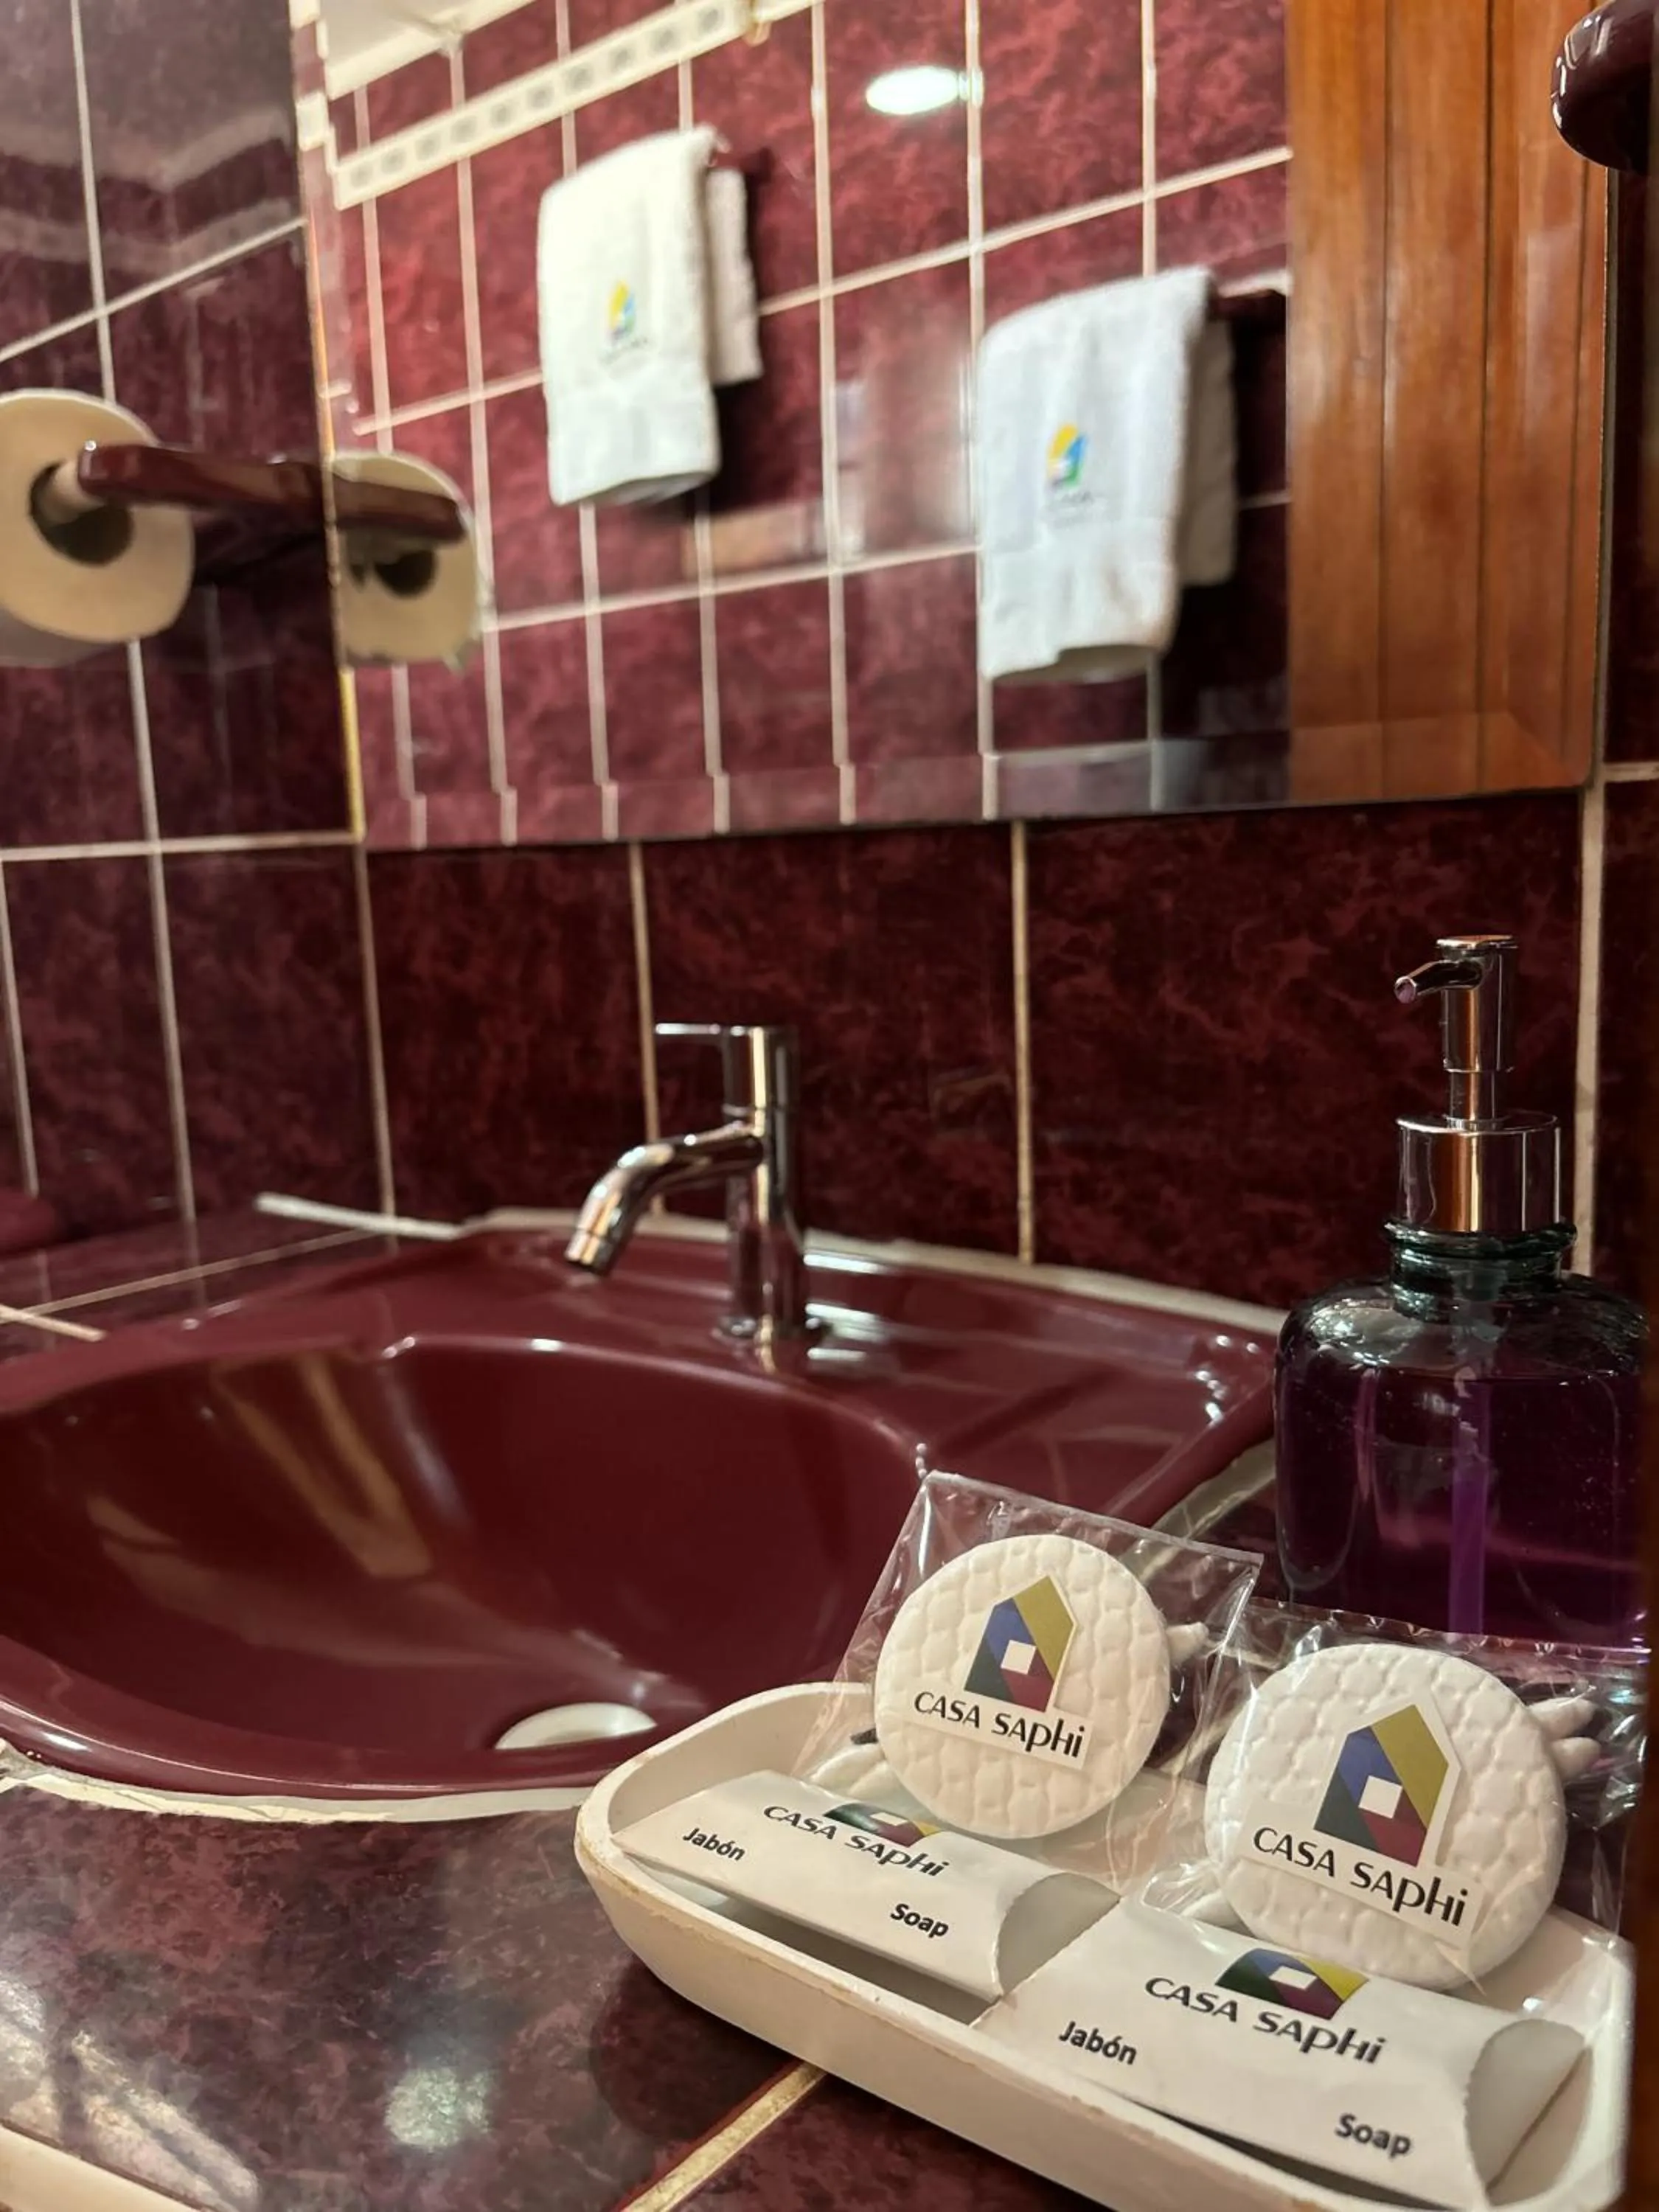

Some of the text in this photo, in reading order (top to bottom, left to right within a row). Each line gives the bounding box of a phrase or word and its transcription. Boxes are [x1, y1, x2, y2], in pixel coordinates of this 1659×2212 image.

[914, 1691, 981, 1728] CASA
[764, 1806, 838, 1840] CASA
[683, 1827, 745, 1861] Jabón
[1253, 1827, 1335, 1877] CASA
[890, 1903, 949, 1938] Soap
[1145, 1977, 1239, 2023] CASA
[1058, 2021, 1138, 2065] Jabón
[1335, 2112, 1411, 2160] Soap
